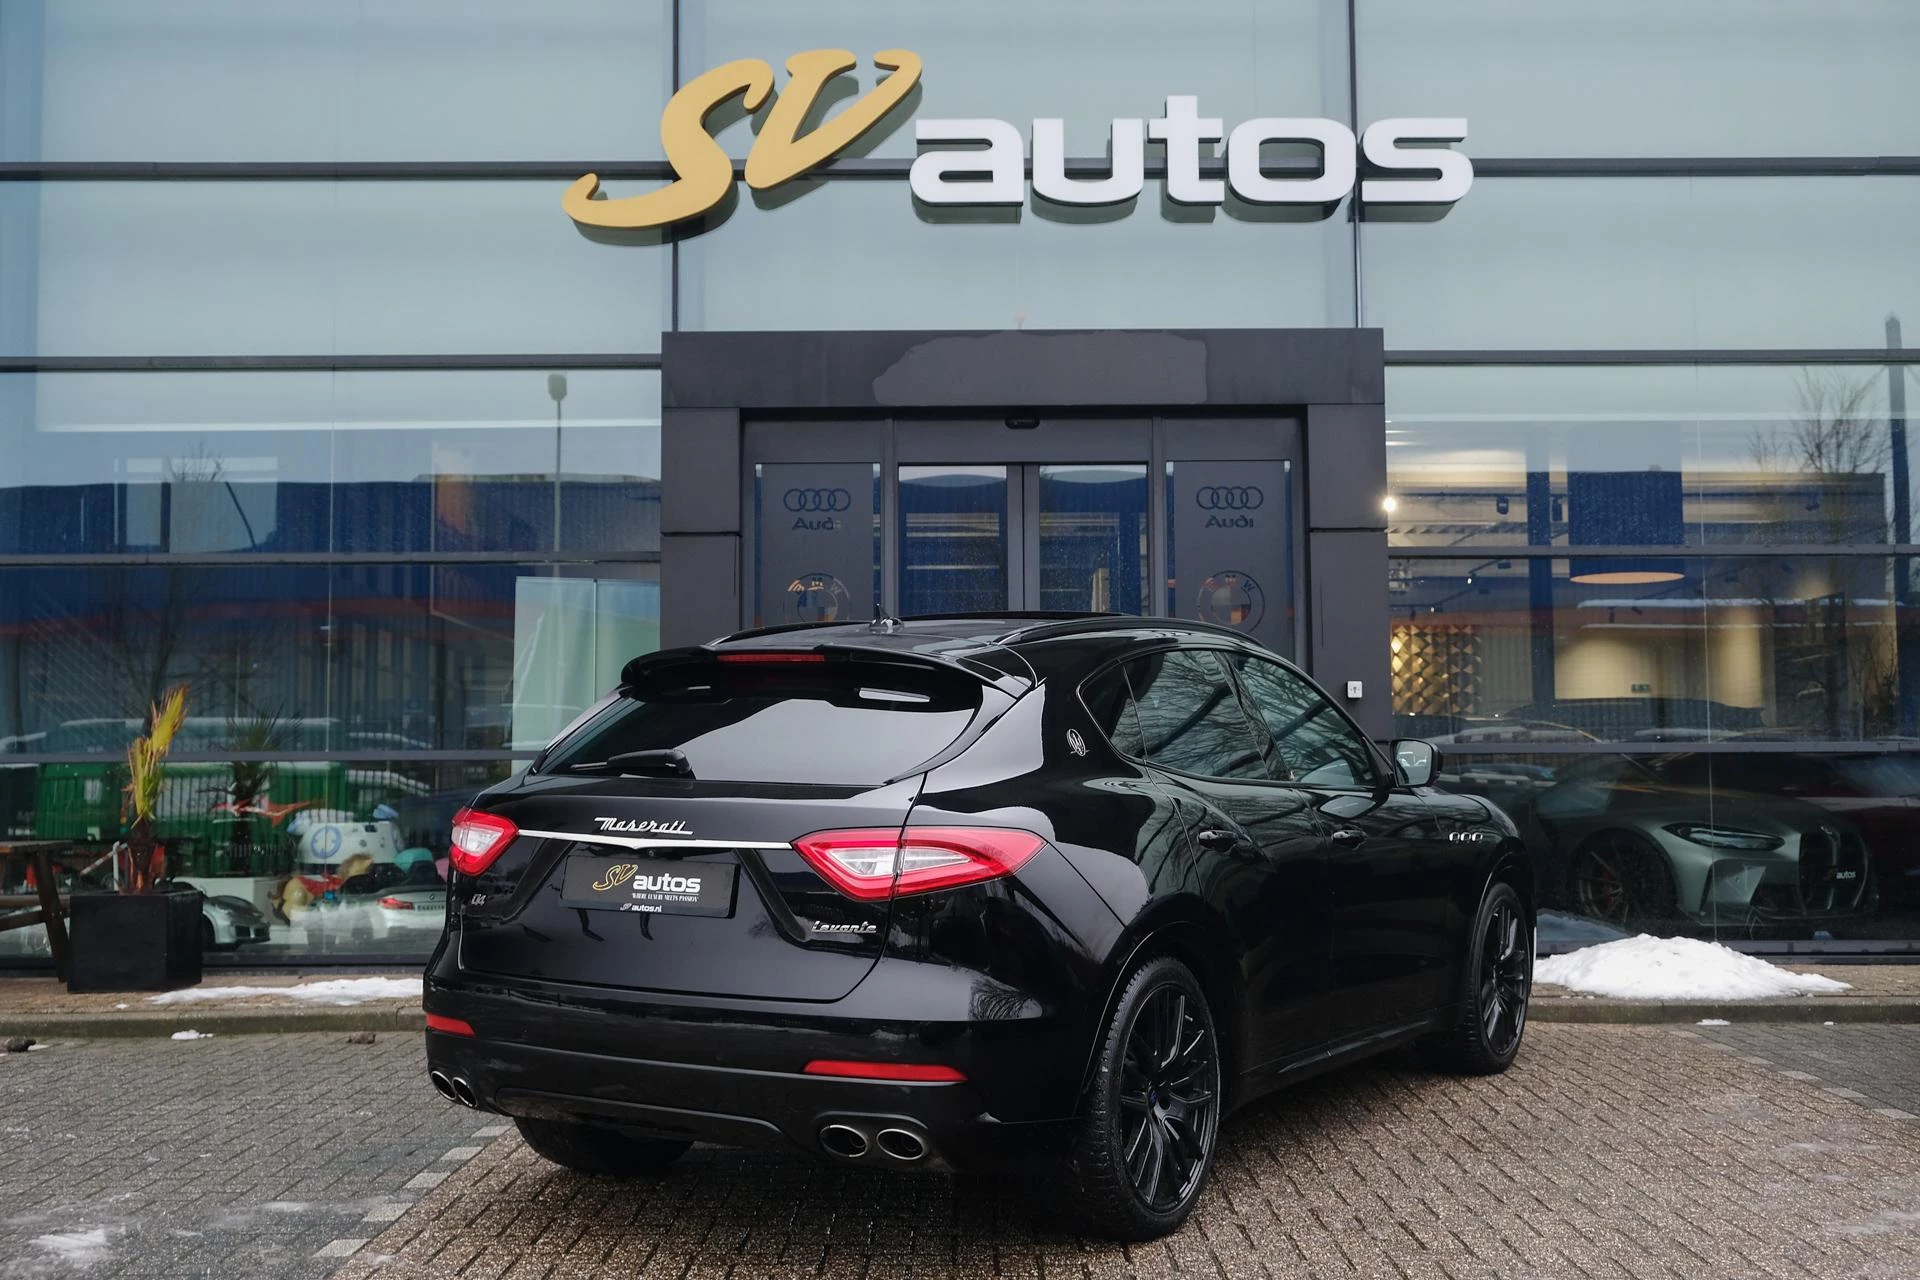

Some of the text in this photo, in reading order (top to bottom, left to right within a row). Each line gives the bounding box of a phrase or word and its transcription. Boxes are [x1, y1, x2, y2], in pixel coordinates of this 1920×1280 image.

[562, 48, 1474, 229] SV autos
[1205, 515, 1254, 528] Audi
[594, 817, 693, 835] Maserati
[592, 864, 701, 893] SV autos
[1836, 871, 1856, 880] autos
[811, 920, 877, 933] Levante
